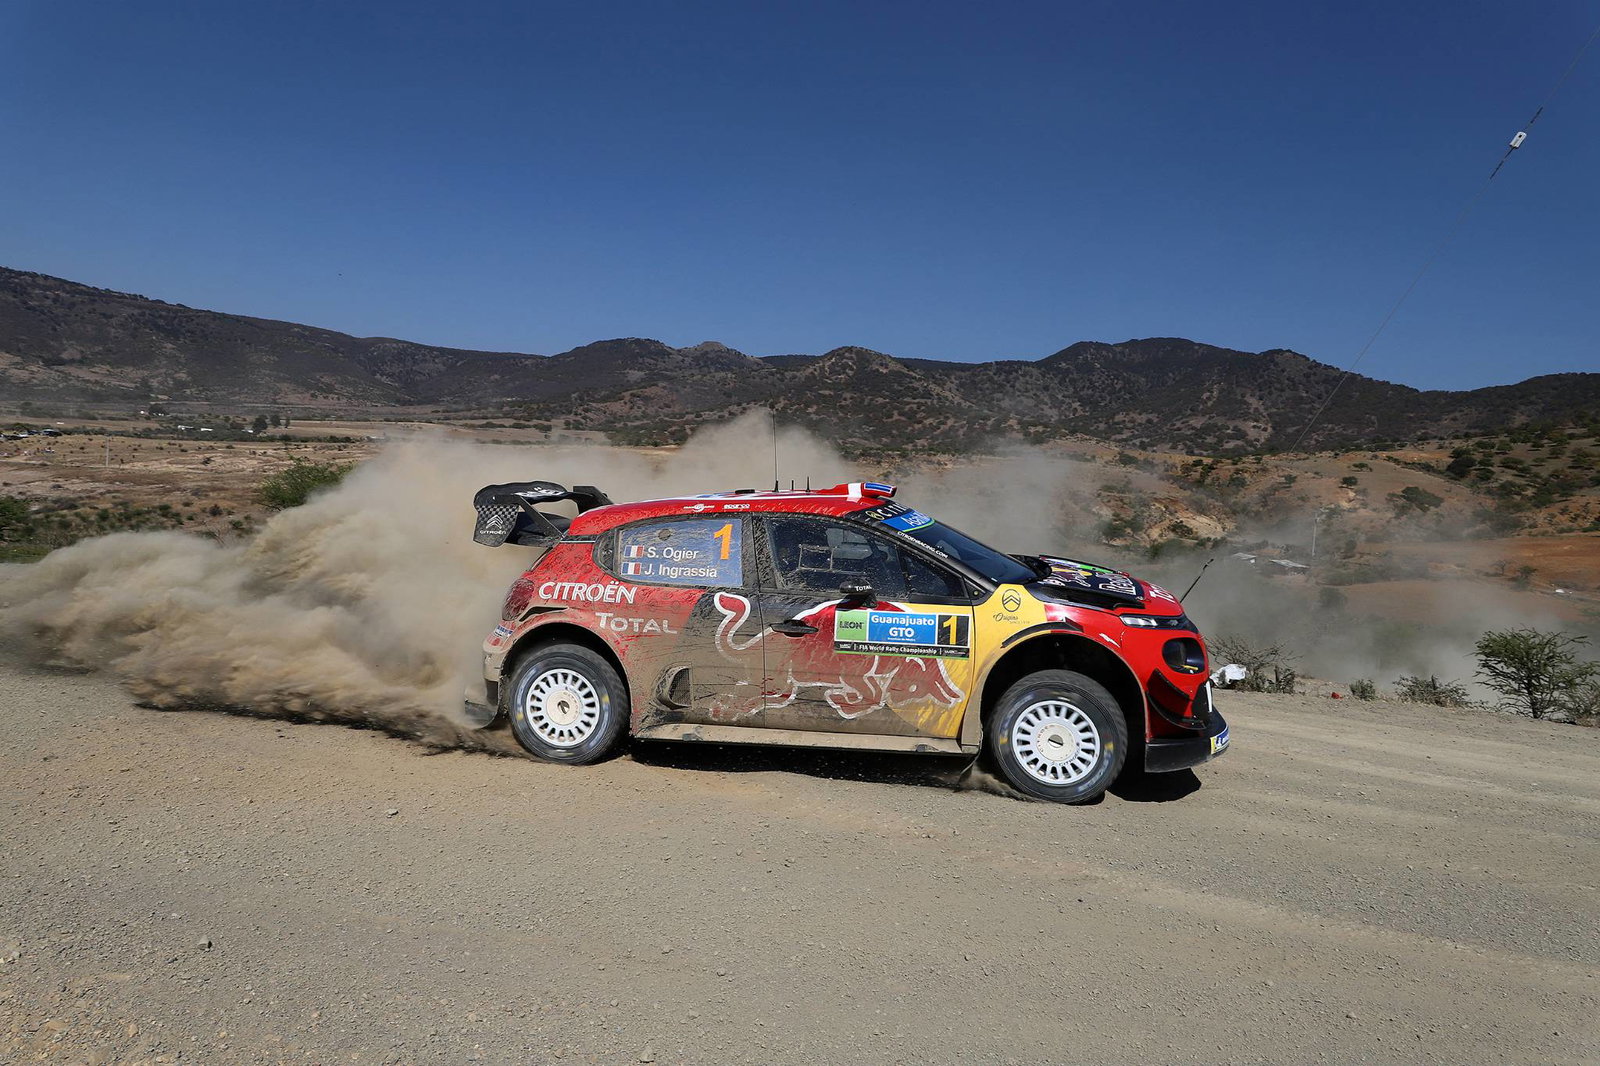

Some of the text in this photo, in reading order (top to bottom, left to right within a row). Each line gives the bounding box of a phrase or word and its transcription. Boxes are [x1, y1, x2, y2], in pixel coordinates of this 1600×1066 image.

[713, 523, 733, 560] 1
[647, 546, 699, 562] S. Ogier
[644, 563, 718, 578] J. Ingrassia
[538, 580, 638, 604] CITROËN
[870, 615, 935, 627] Guanajuato
[888, 627, 915, 638] GTO
[942, 615, 958, 645] 1
[899, 647, 937, 655] Championship
